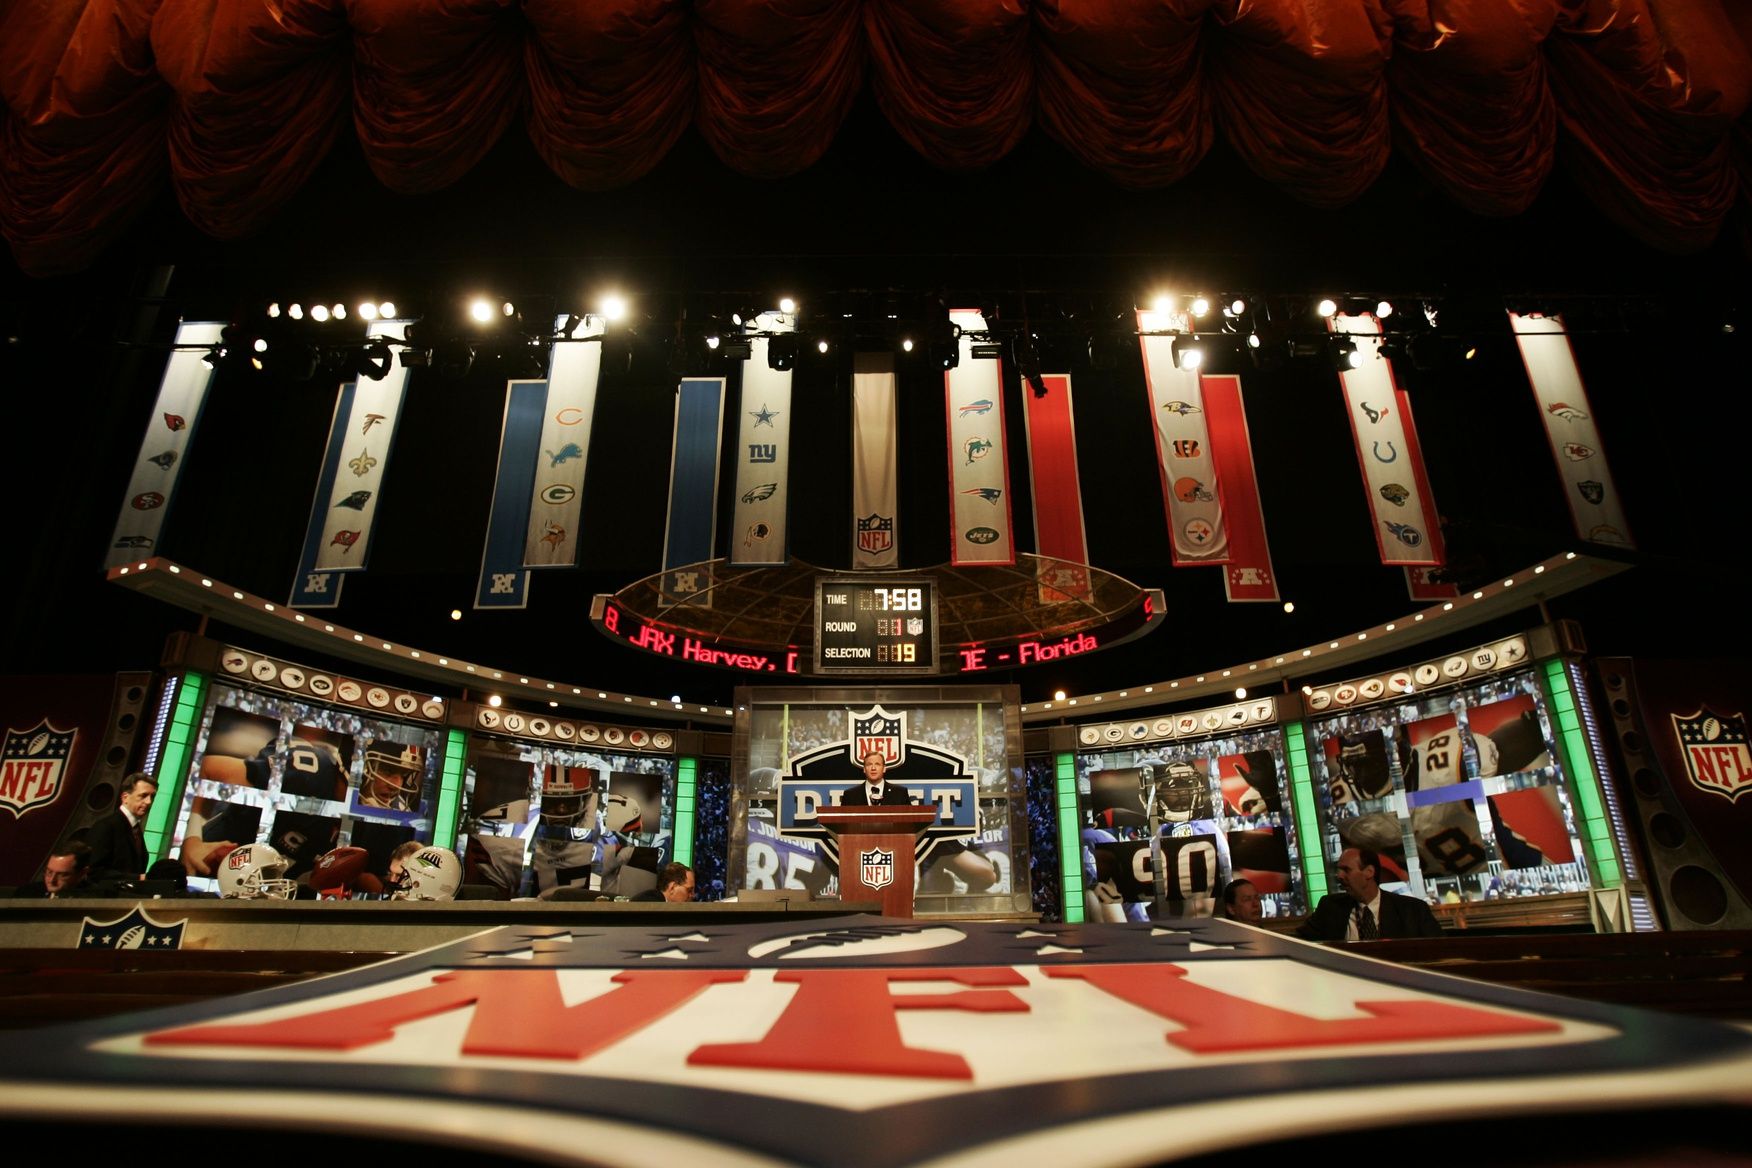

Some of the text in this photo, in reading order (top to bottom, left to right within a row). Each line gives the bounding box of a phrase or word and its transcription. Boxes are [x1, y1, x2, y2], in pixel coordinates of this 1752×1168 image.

[748, 444, 776, 463] ny
[860, 531, 890, 551] NFL
[826, 588, 922, 611] TIME 7:58
[825, 621, 857, 632] ROUND
[629, 625, 675, 655] JAX
[683, 638, 777, 671] Harvey,
[825, 644, 916, 662] SELECTION 19
[1019, 633, 1098, 665] Florida
[1690, 746, 1752, 788] NFL
[0, 762, 54, 803] NFL
[865, 866, 889, 883] NFL
[142, 964, 1564, 1083] NFL
